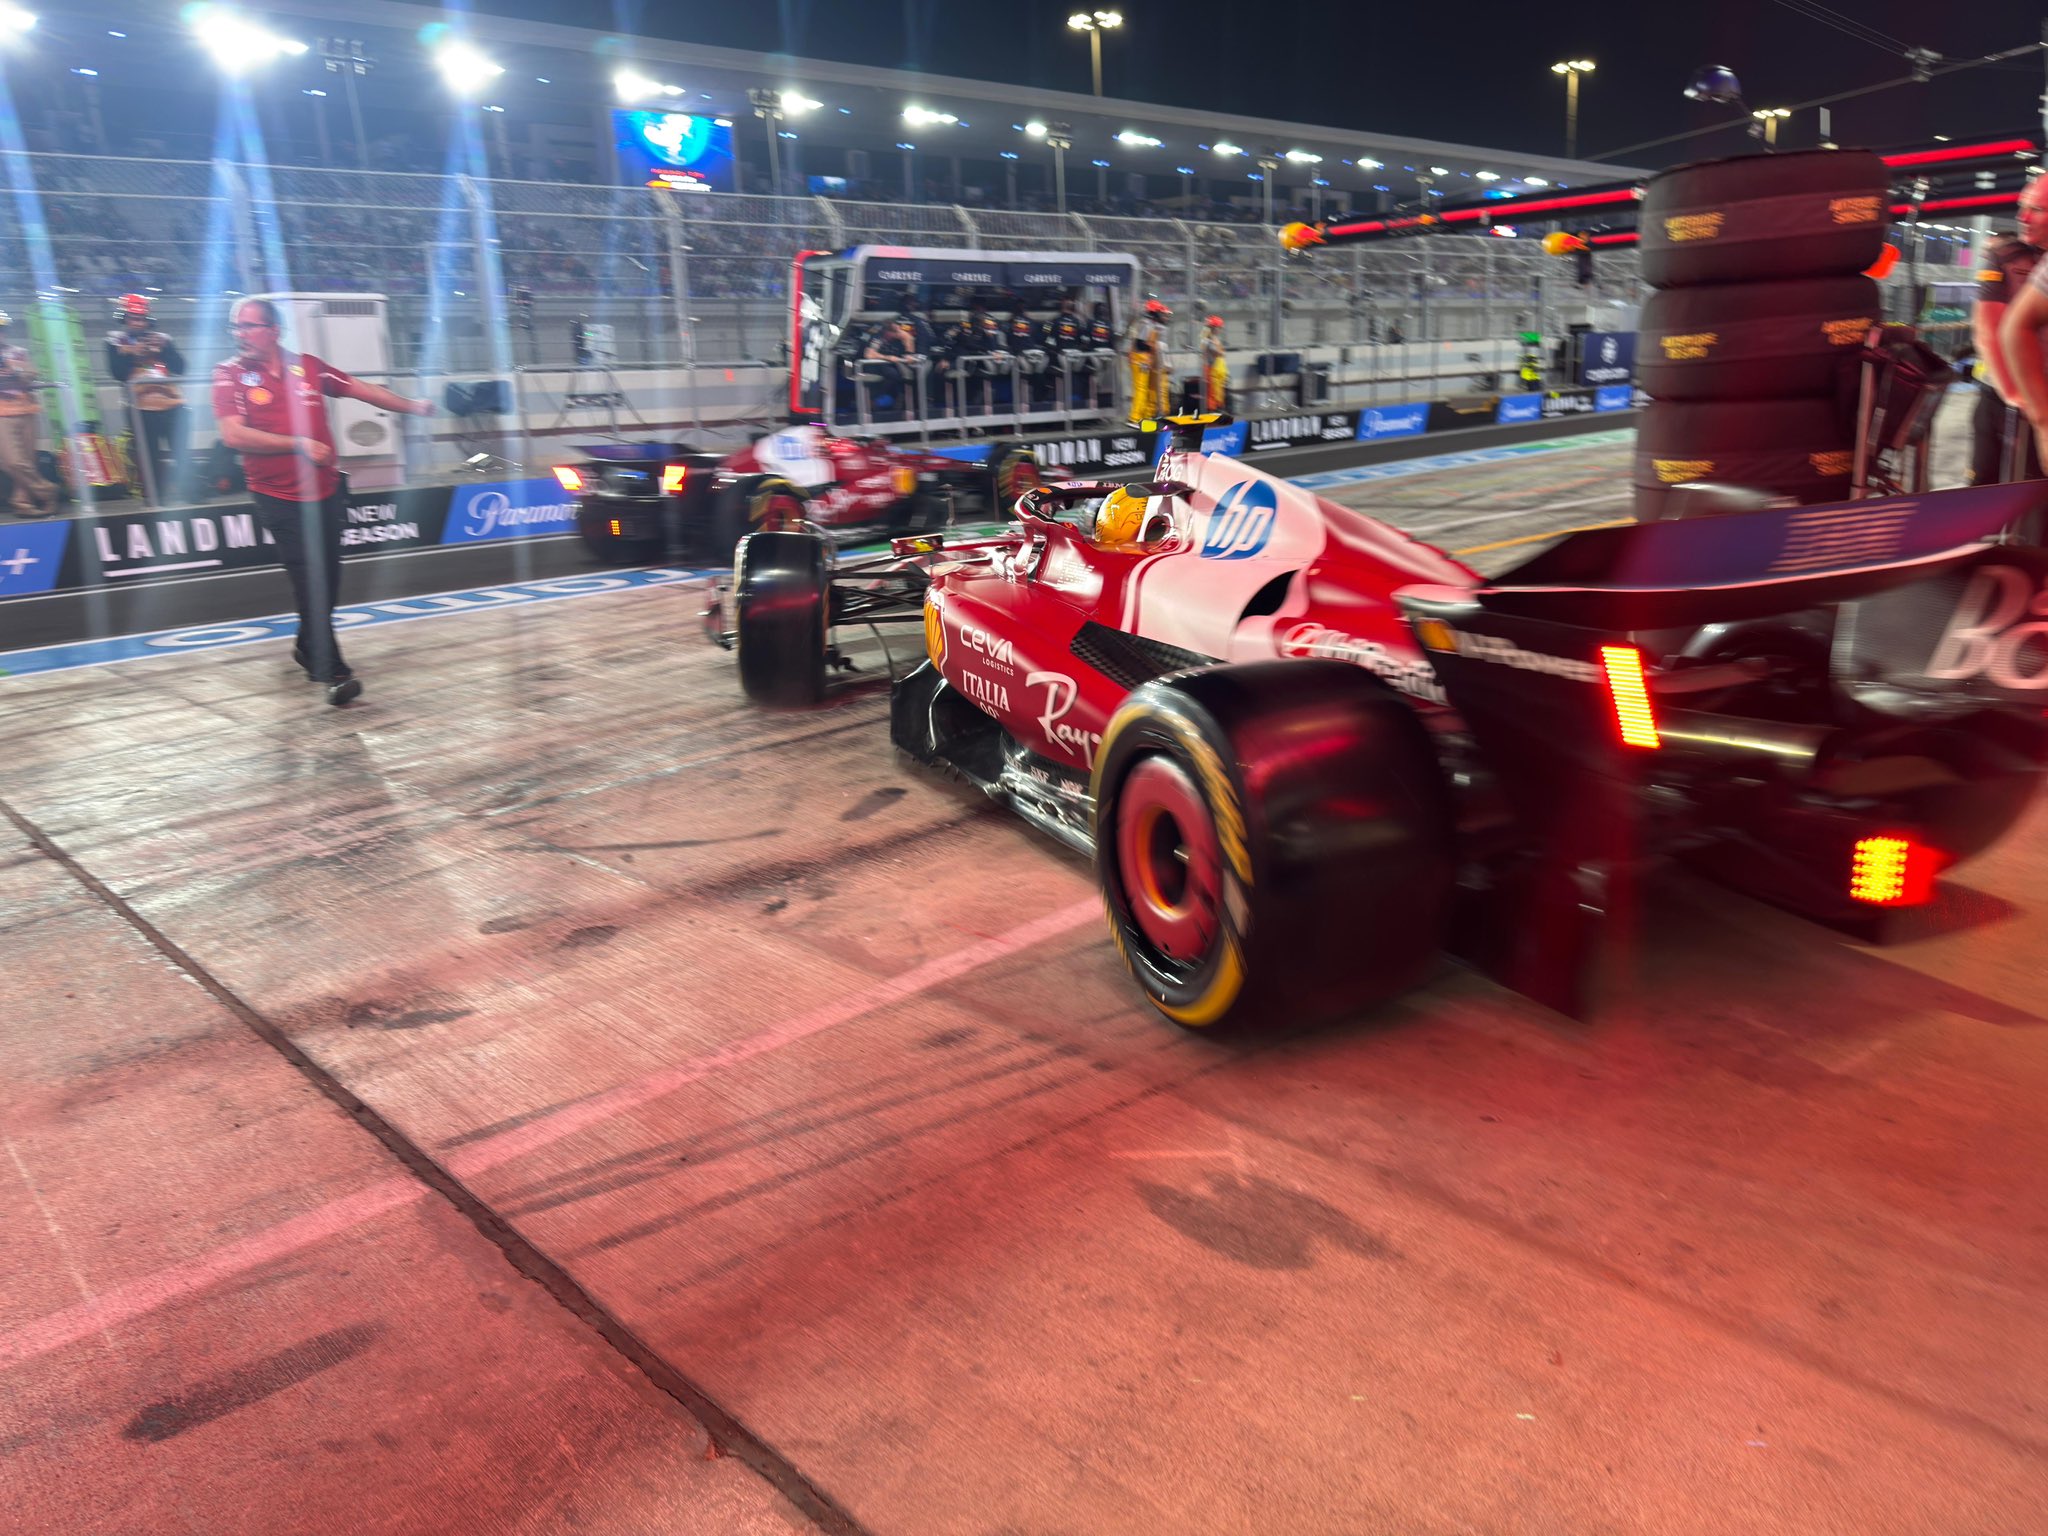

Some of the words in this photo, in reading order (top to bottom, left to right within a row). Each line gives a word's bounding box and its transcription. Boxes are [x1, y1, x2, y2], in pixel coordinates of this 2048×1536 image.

[1251, 415, 1321, 442] LANDMAN
[1032, 438, 1102, 467] NDMAN
[1112, 437, 1138, 451] NEW
[1104, 450, 1146, 466] SEASON
[346, 504, 397, 524] NEW
[1205, 484, 1274, 558] hp
[982, 657, 1014, 676] LOGISTICS
[962, 669, 1011, 712] ITALIA
